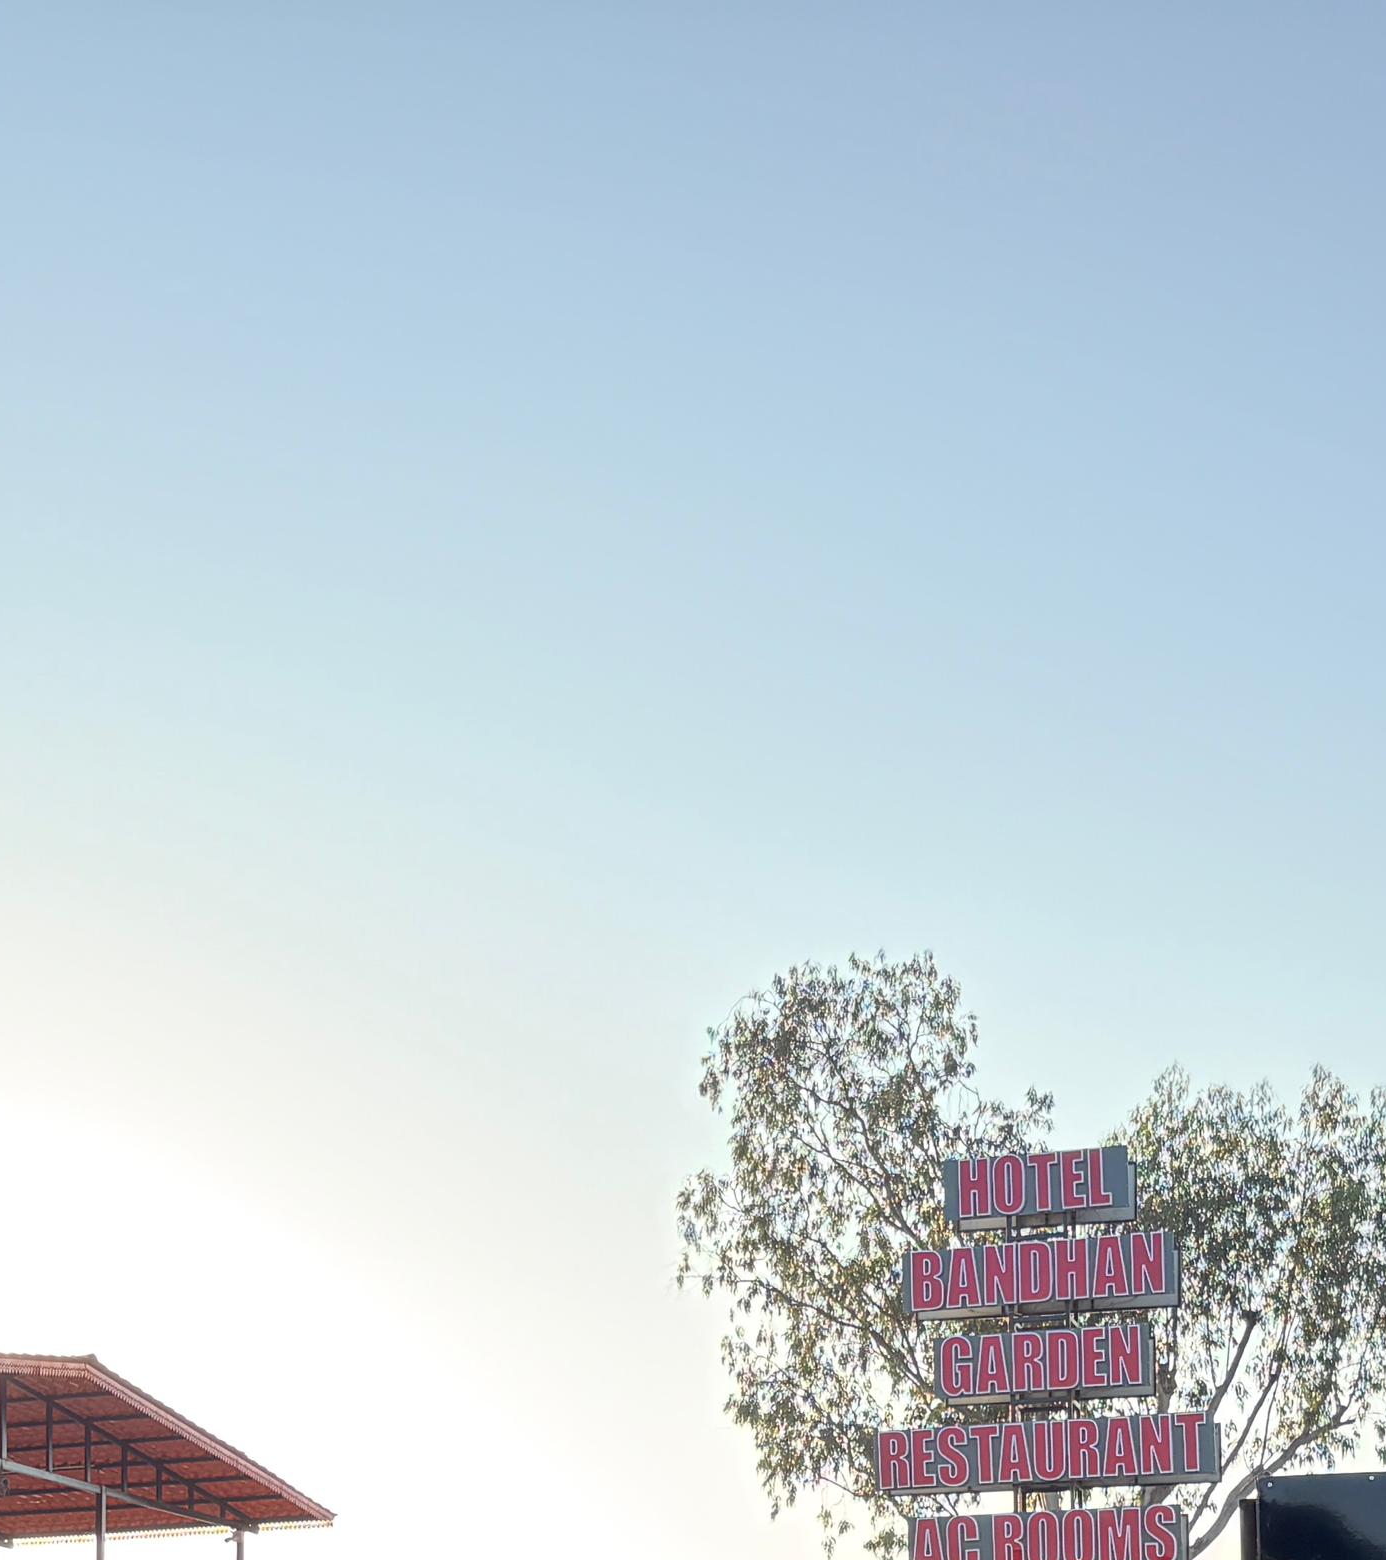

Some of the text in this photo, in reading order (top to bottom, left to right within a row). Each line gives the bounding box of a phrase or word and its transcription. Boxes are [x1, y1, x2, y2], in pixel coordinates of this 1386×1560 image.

[959, 1149, 1112, 1217] HOTEL
[911, 1232, 1166, 1312] BANDHAN
[940, 1324, 1142, 1397] GARDEN
[879, 1413, 1206, 1490] RESTAURANT
